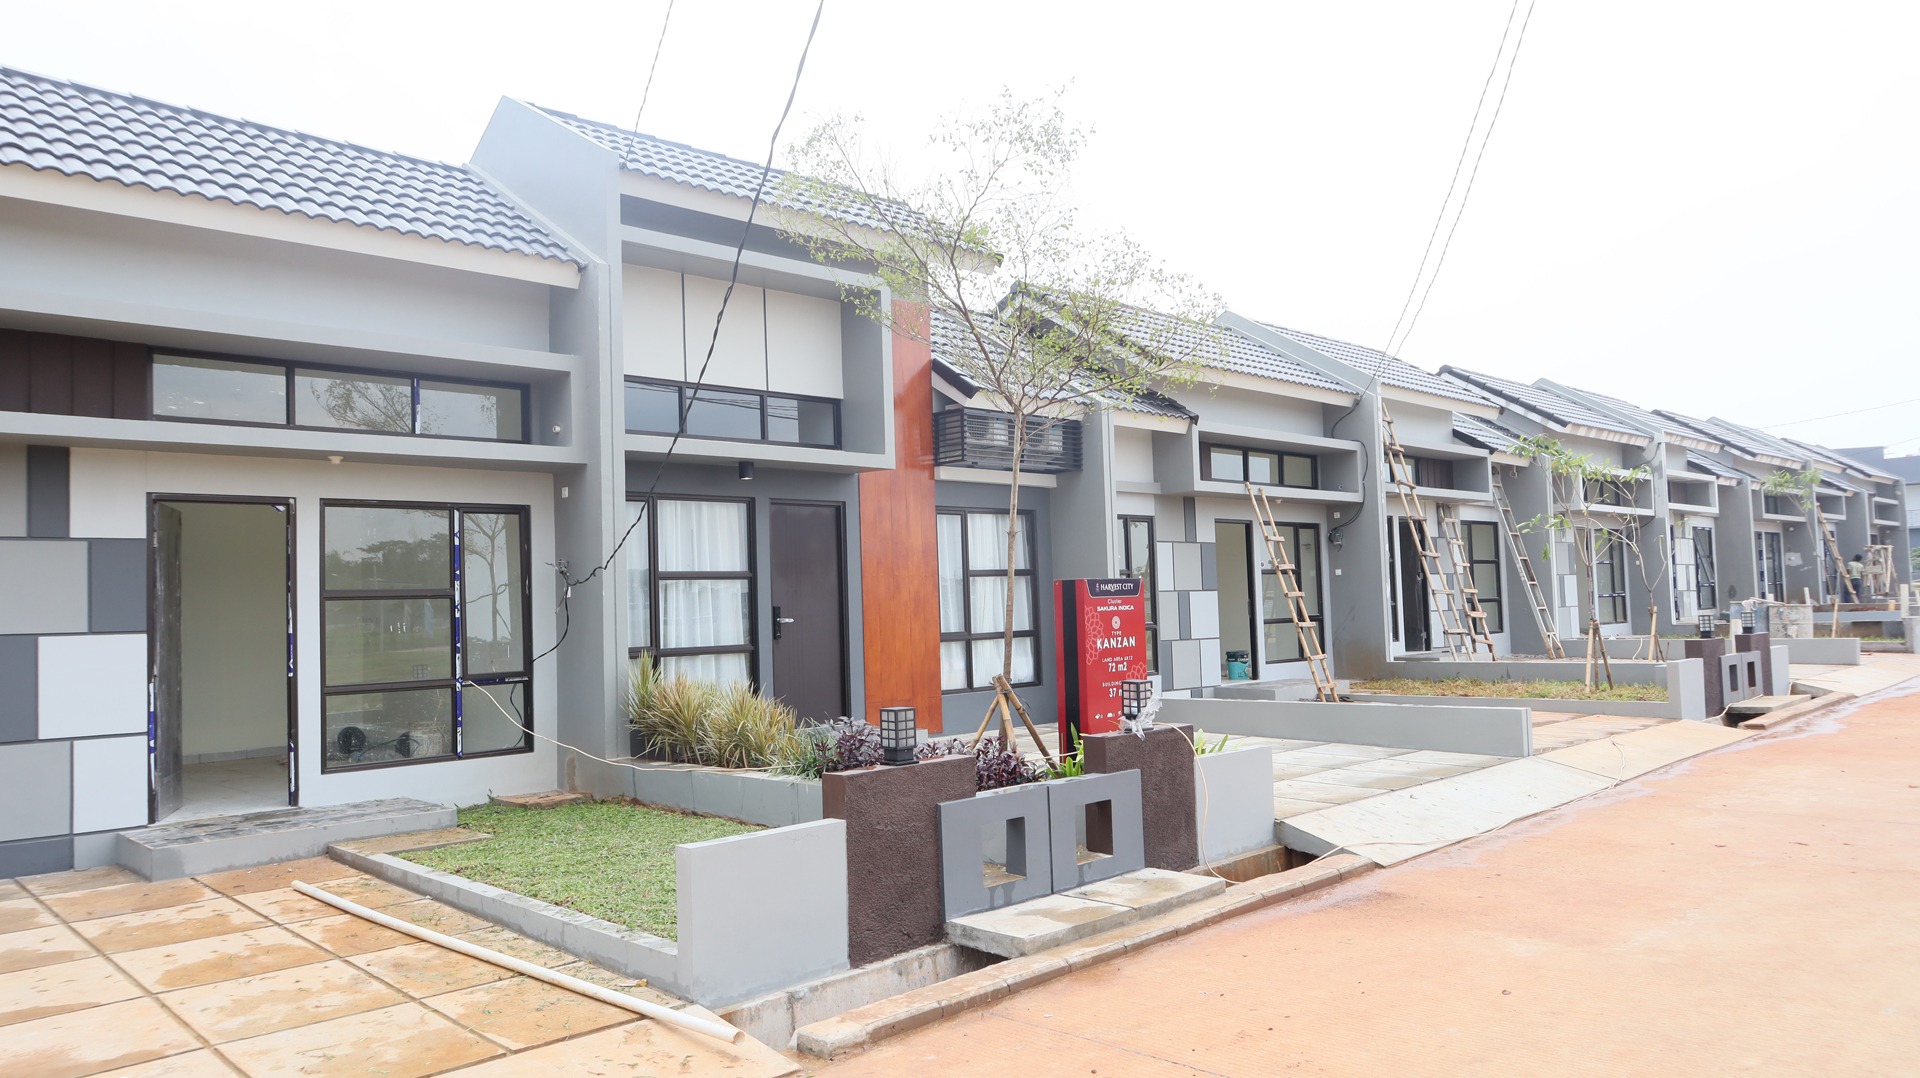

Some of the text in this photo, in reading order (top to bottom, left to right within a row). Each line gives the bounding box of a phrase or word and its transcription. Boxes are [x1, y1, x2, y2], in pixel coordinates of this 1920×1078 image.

[1101, 584, 1122, 592] HARVEST
[1097, 637, 1136, 649] KANZAN
[1108, 662, 1127, 672] 72 m2
[1109, 687, 1116, 697] 37
